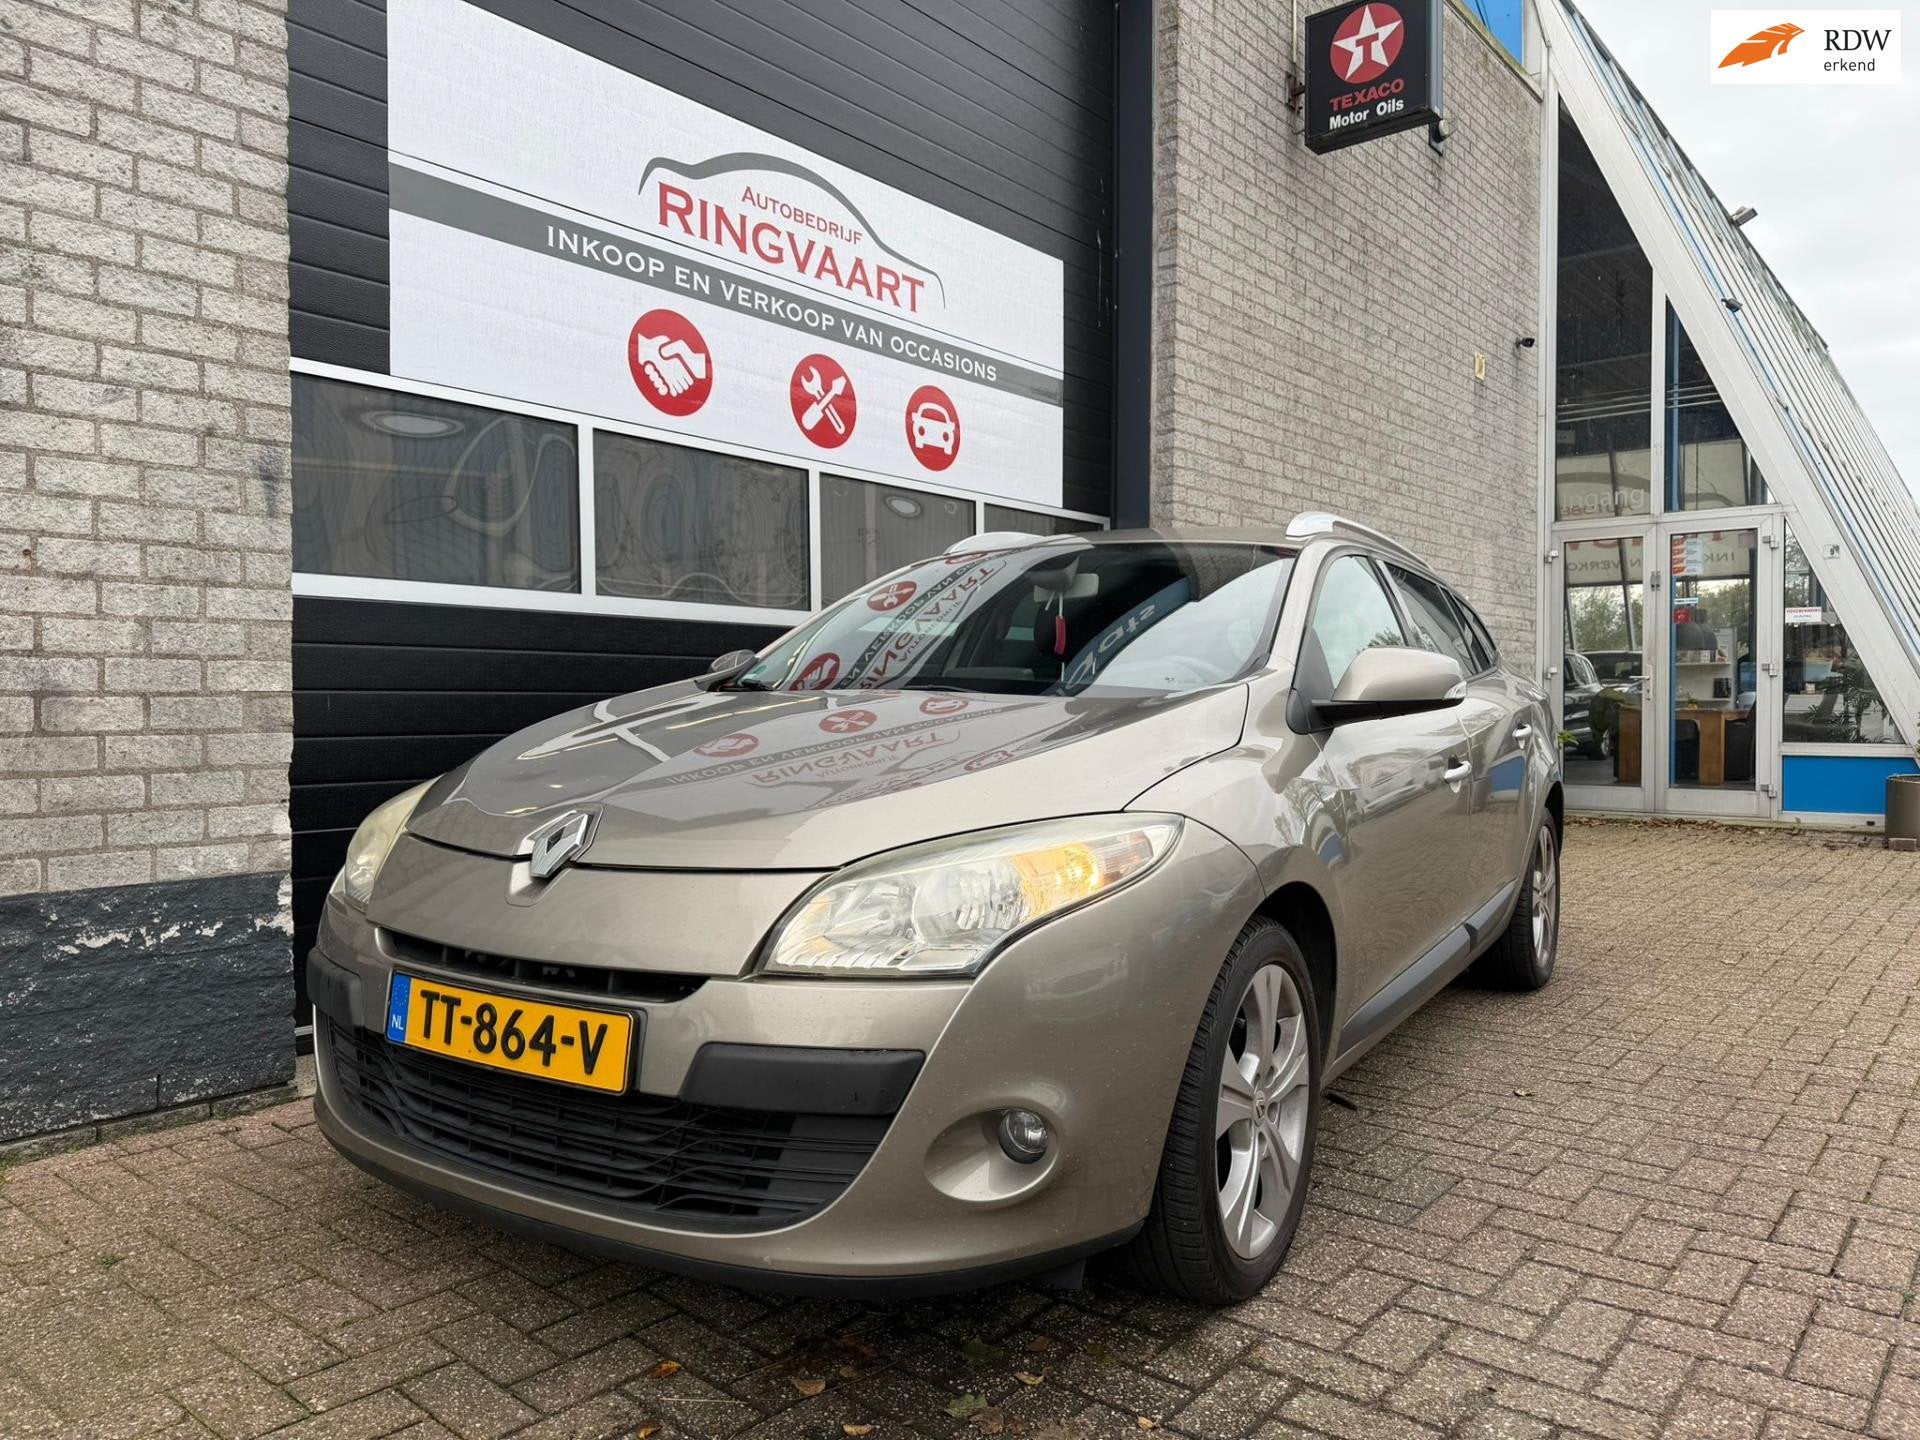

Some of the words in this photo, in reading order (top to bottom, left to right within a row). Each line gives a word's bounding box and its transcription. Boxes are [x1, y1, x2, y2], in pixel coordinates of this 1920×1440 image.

[1329, 78, 1405, 112] TEXACO
[1329, 109, 1369, 130] Motor
[1376, 98, 1404, 116] Oils
[742, 186, 863, 246] AUTOBEDRIJF
[658, 181, 925, 313] RINGVAART
[547, 225, 666, 279] INKOOP
[675, 265, 711, 295] EN
[719, 279, 835, 332] VERKOOP
[841, 318, 883, 348] VAN
[890, 335, 997, 382] OCCASIONS
[391, 1015, 404, 1031] NL
[420, 989, 608, 1076] TT-864-V
